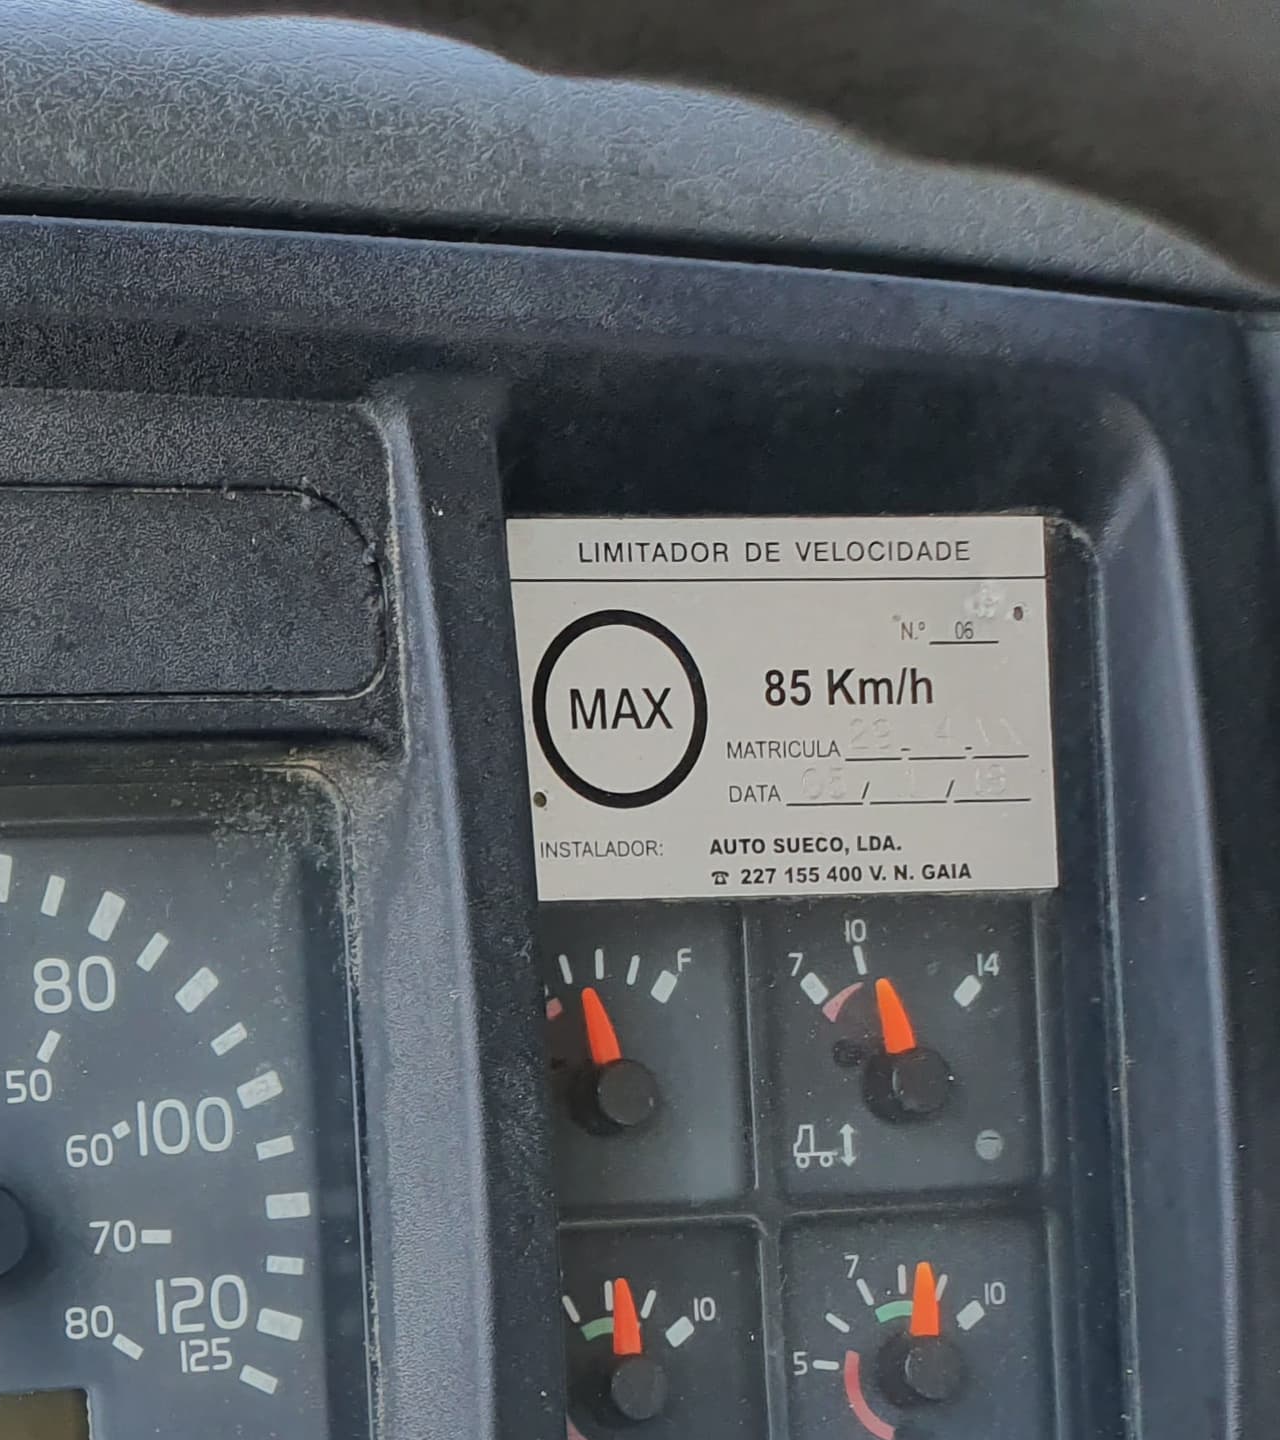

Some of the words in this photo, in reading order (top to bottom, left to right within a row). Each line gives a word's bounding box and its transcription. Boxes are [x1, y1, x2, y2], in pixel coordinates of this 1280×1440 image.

[578, 541, 729, 563] LIMITADOR
[745, 541, 781, 562] DE
[795, 540, 971, 562] VELOCIDADE
[764, 669, 812, 706] 85
[826, 667, 935, 705] Km/h
[569, 687, 674, 730] MAX
[726, 739, 841, 760] MATRICULA
[729, 784, 782, 804] DATA
[539, 839, 665, 860] INSTALADOR:
[709, 837, 766, 855] AUTO
[773, 836, 851, 856] SUECO,
[856, 835, 903, 852] LDA.
[740, 867, 778, 884] 227
[785, 866, 821, 883] 155
[826, 865, 863, 882] 400
[869, 864, 888, 881] V.
[893, 864, 916, 881] N.
[921, 862, 972, 881] GAIA
[844, 919, 867, 943] 10
[677, 948, 692, 973] F
[788, 953, 804, 976] 7
[976, 953, 1000, 977] 14
[33, 956, 117, 1015] 80
[4, 1068, 54, 1105] 50
[135, 1096, 234, 1157] 100
[64, 1132, 114, 1169] 60
[87, 1219, 137, 1255] 70
[844, 1255, 860, 1279] 7
[155, 1273, 249, 1336] 120
[983, 1283, 1007, 1306] 10
[64, 1304, 114, 1340] 80
[692, 1298, 717, 1321] 10
[178, 1336, 233, 1374] 125
[793, 1351, 809, 1376] 5
